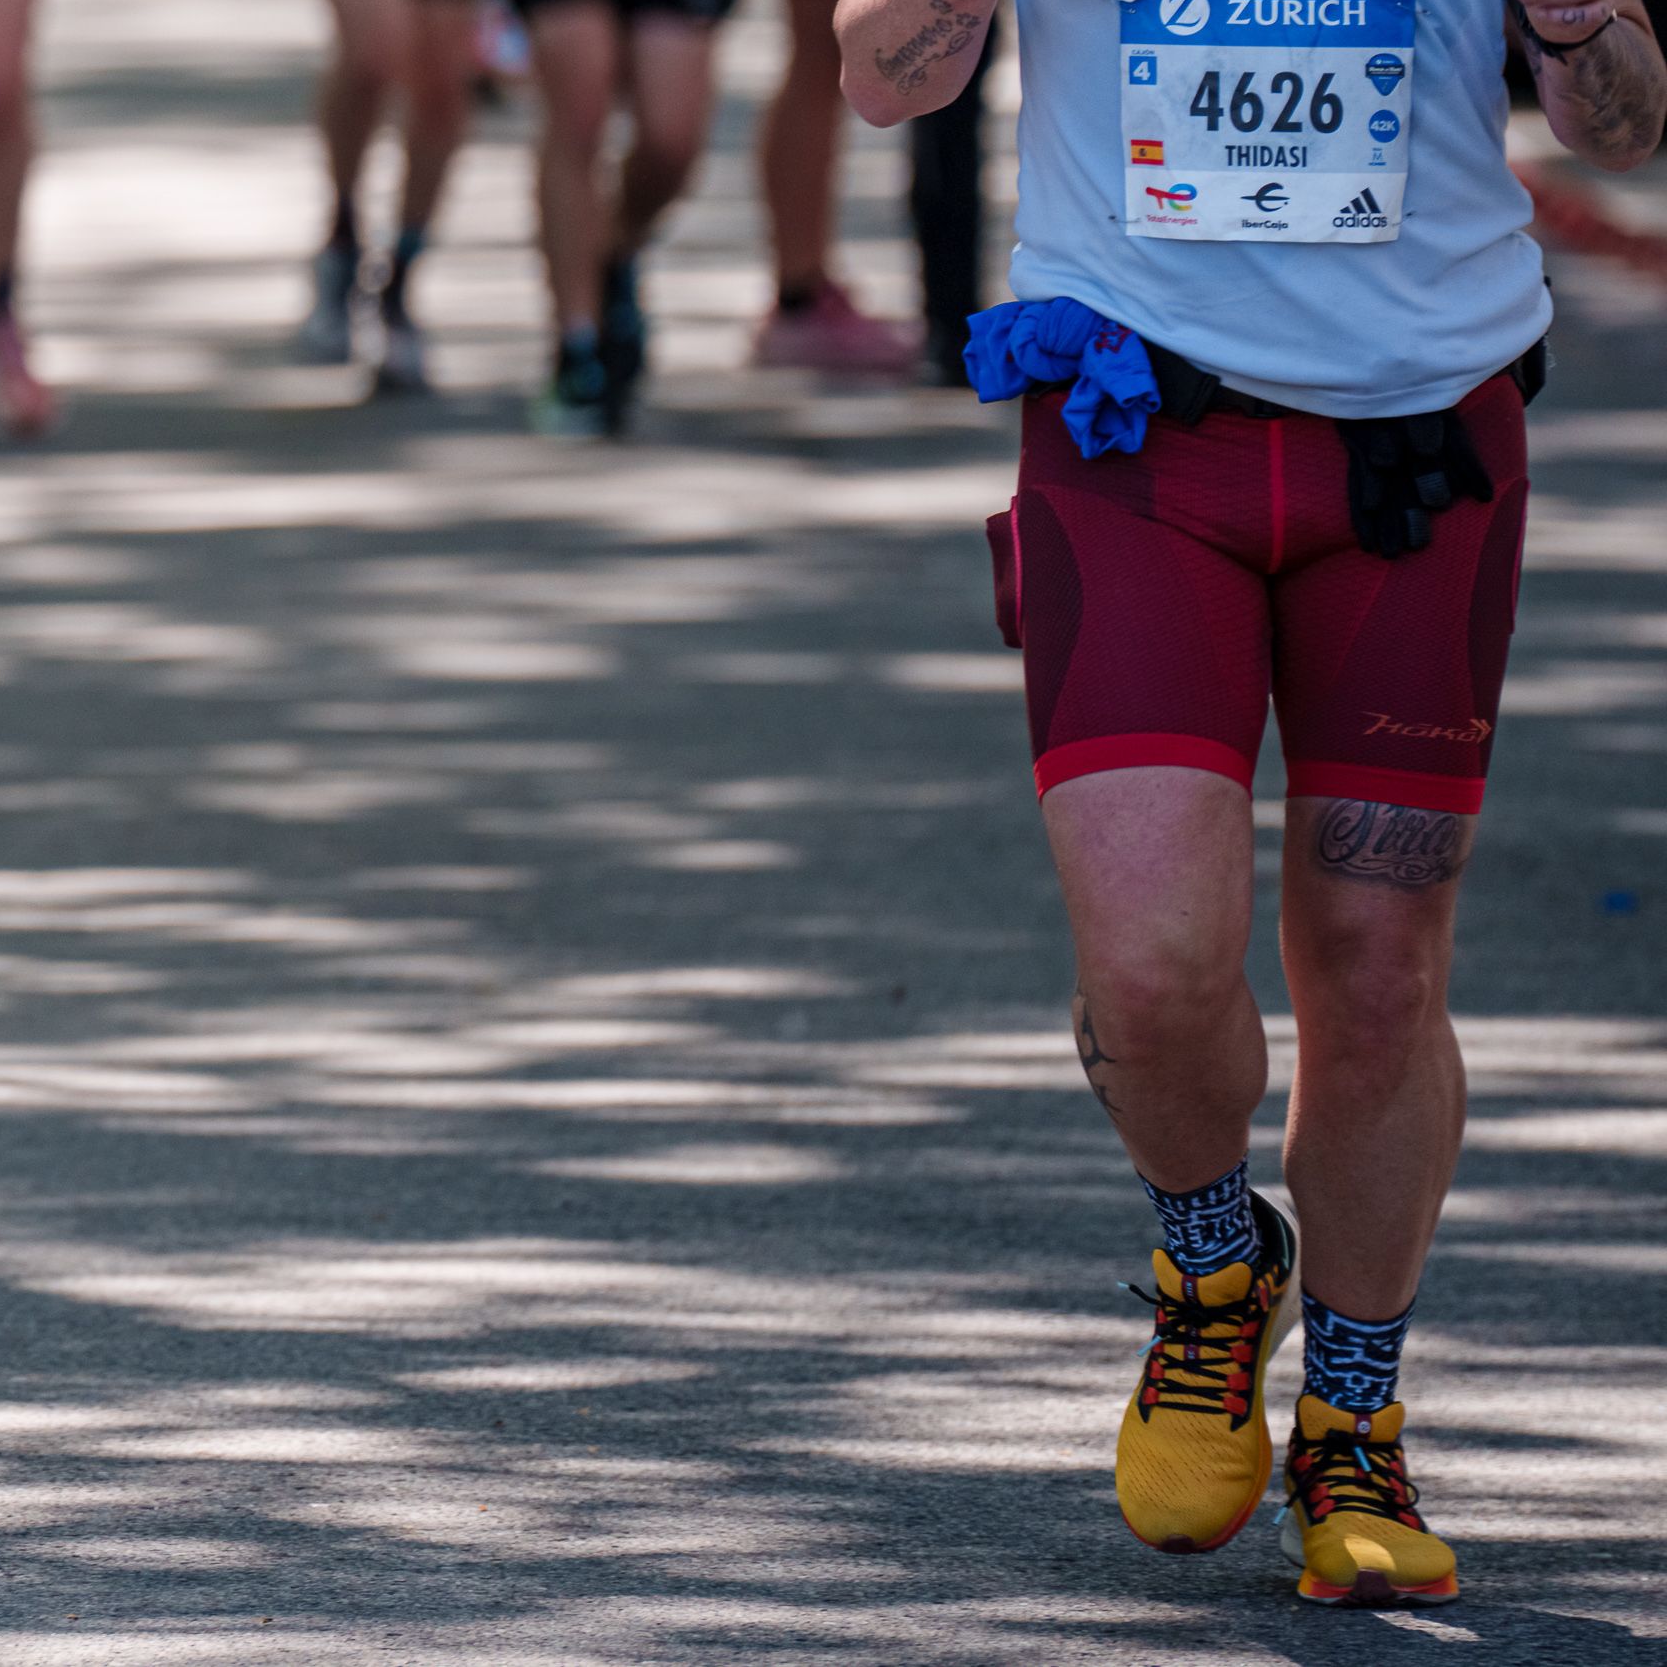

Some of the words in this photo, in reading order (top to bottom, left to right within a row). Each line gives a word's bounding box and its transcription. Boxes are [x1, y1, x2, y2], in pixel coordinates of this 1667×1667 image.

[1133, 61, 1151, 81] 4
[1189, 70, 1345, 134] 4626
[1370, 120, 1396, 132] 42K
[1225, 144, 1308, 168] THIDASI
[1332, 213, 1388, 229] adidas
